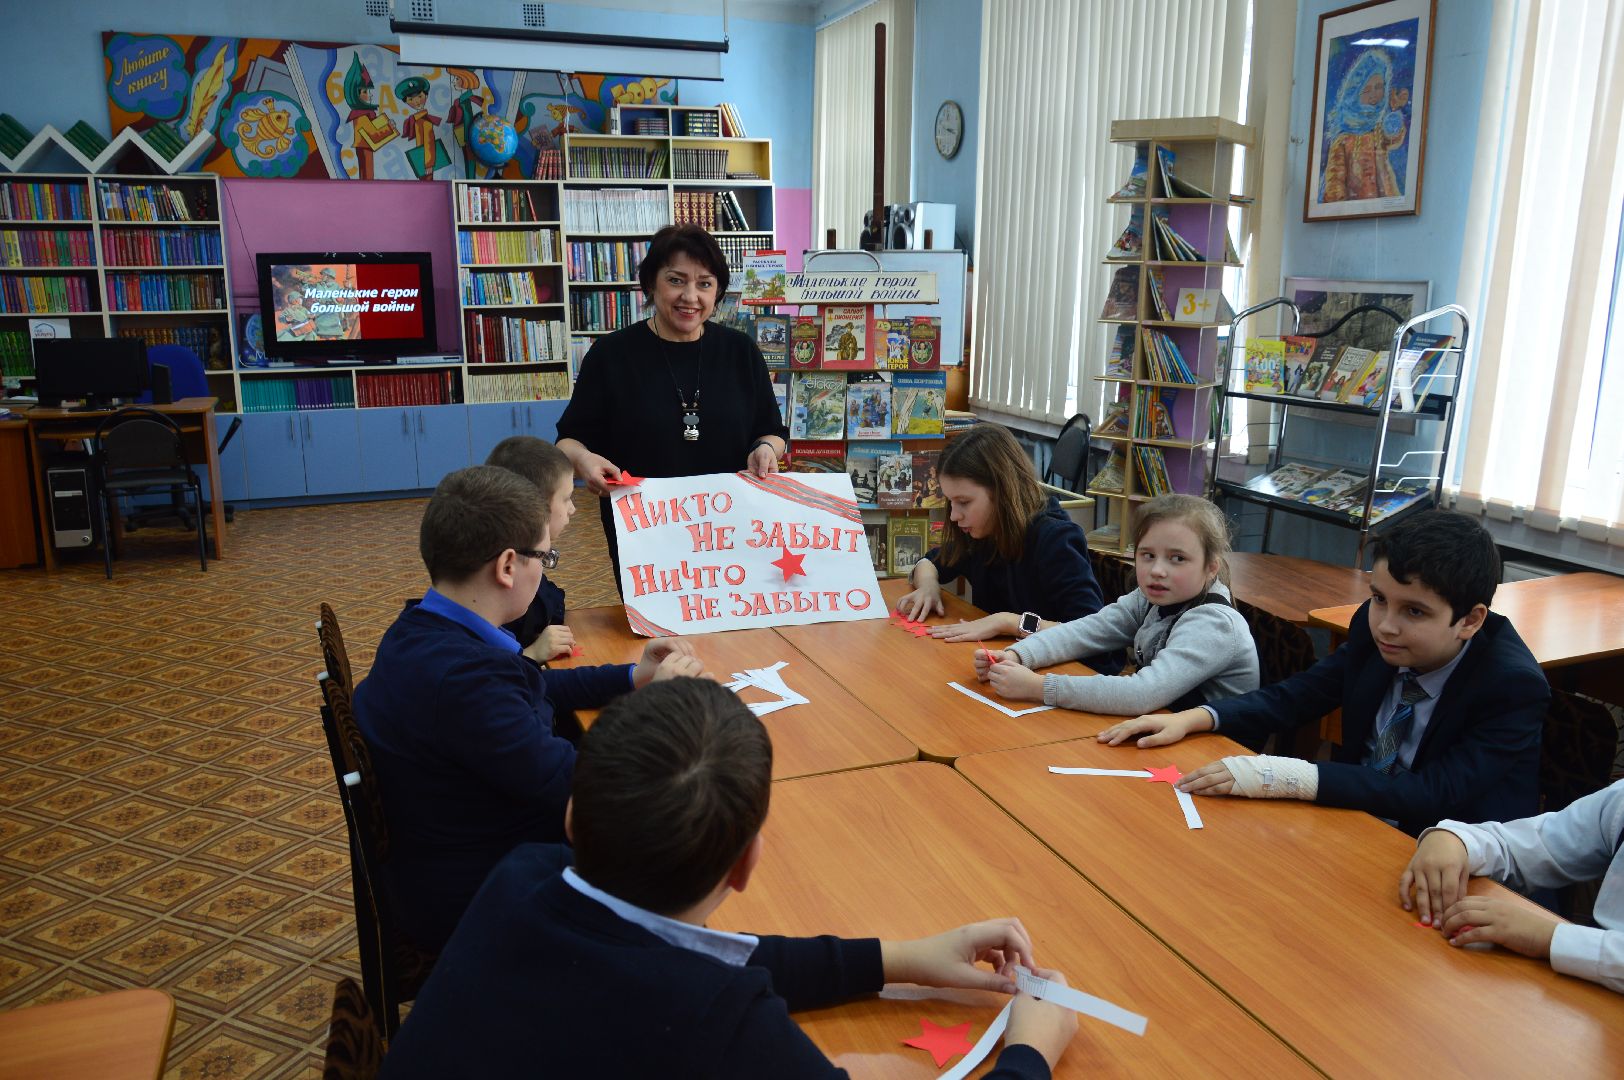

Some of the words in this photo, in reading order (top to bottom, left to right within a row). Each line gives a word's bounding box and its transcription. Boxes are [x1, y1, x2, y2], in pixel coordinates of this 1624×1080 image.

[114, 47, 169, 86] Любите
[128, 67, 167, 95] книгу
[304, 288, 378, 299] Маленькие
[380, 288, 419, 299] герои
[787, 274, 867, 288] Маленькие
[875, 276, 918, 289] герои
[801, 287, 863, 300] большой
[870, 287, 921, 300] войны
[310, 301, 370, 313] большой
[372, 301, 415, 312] войны
[1183, 293, 1211, 315] 3+
[616, 491, 733, 532] НИКТО
[685, 522, 736, 552] НЕ
[746, 519, 865, 552] ЗАБЫТ
[627, 560, 746, 597] НИЧТО
[678, 593, 722, 622] НЕ
[728, 588, 871, 617] ЗАБЫТО
